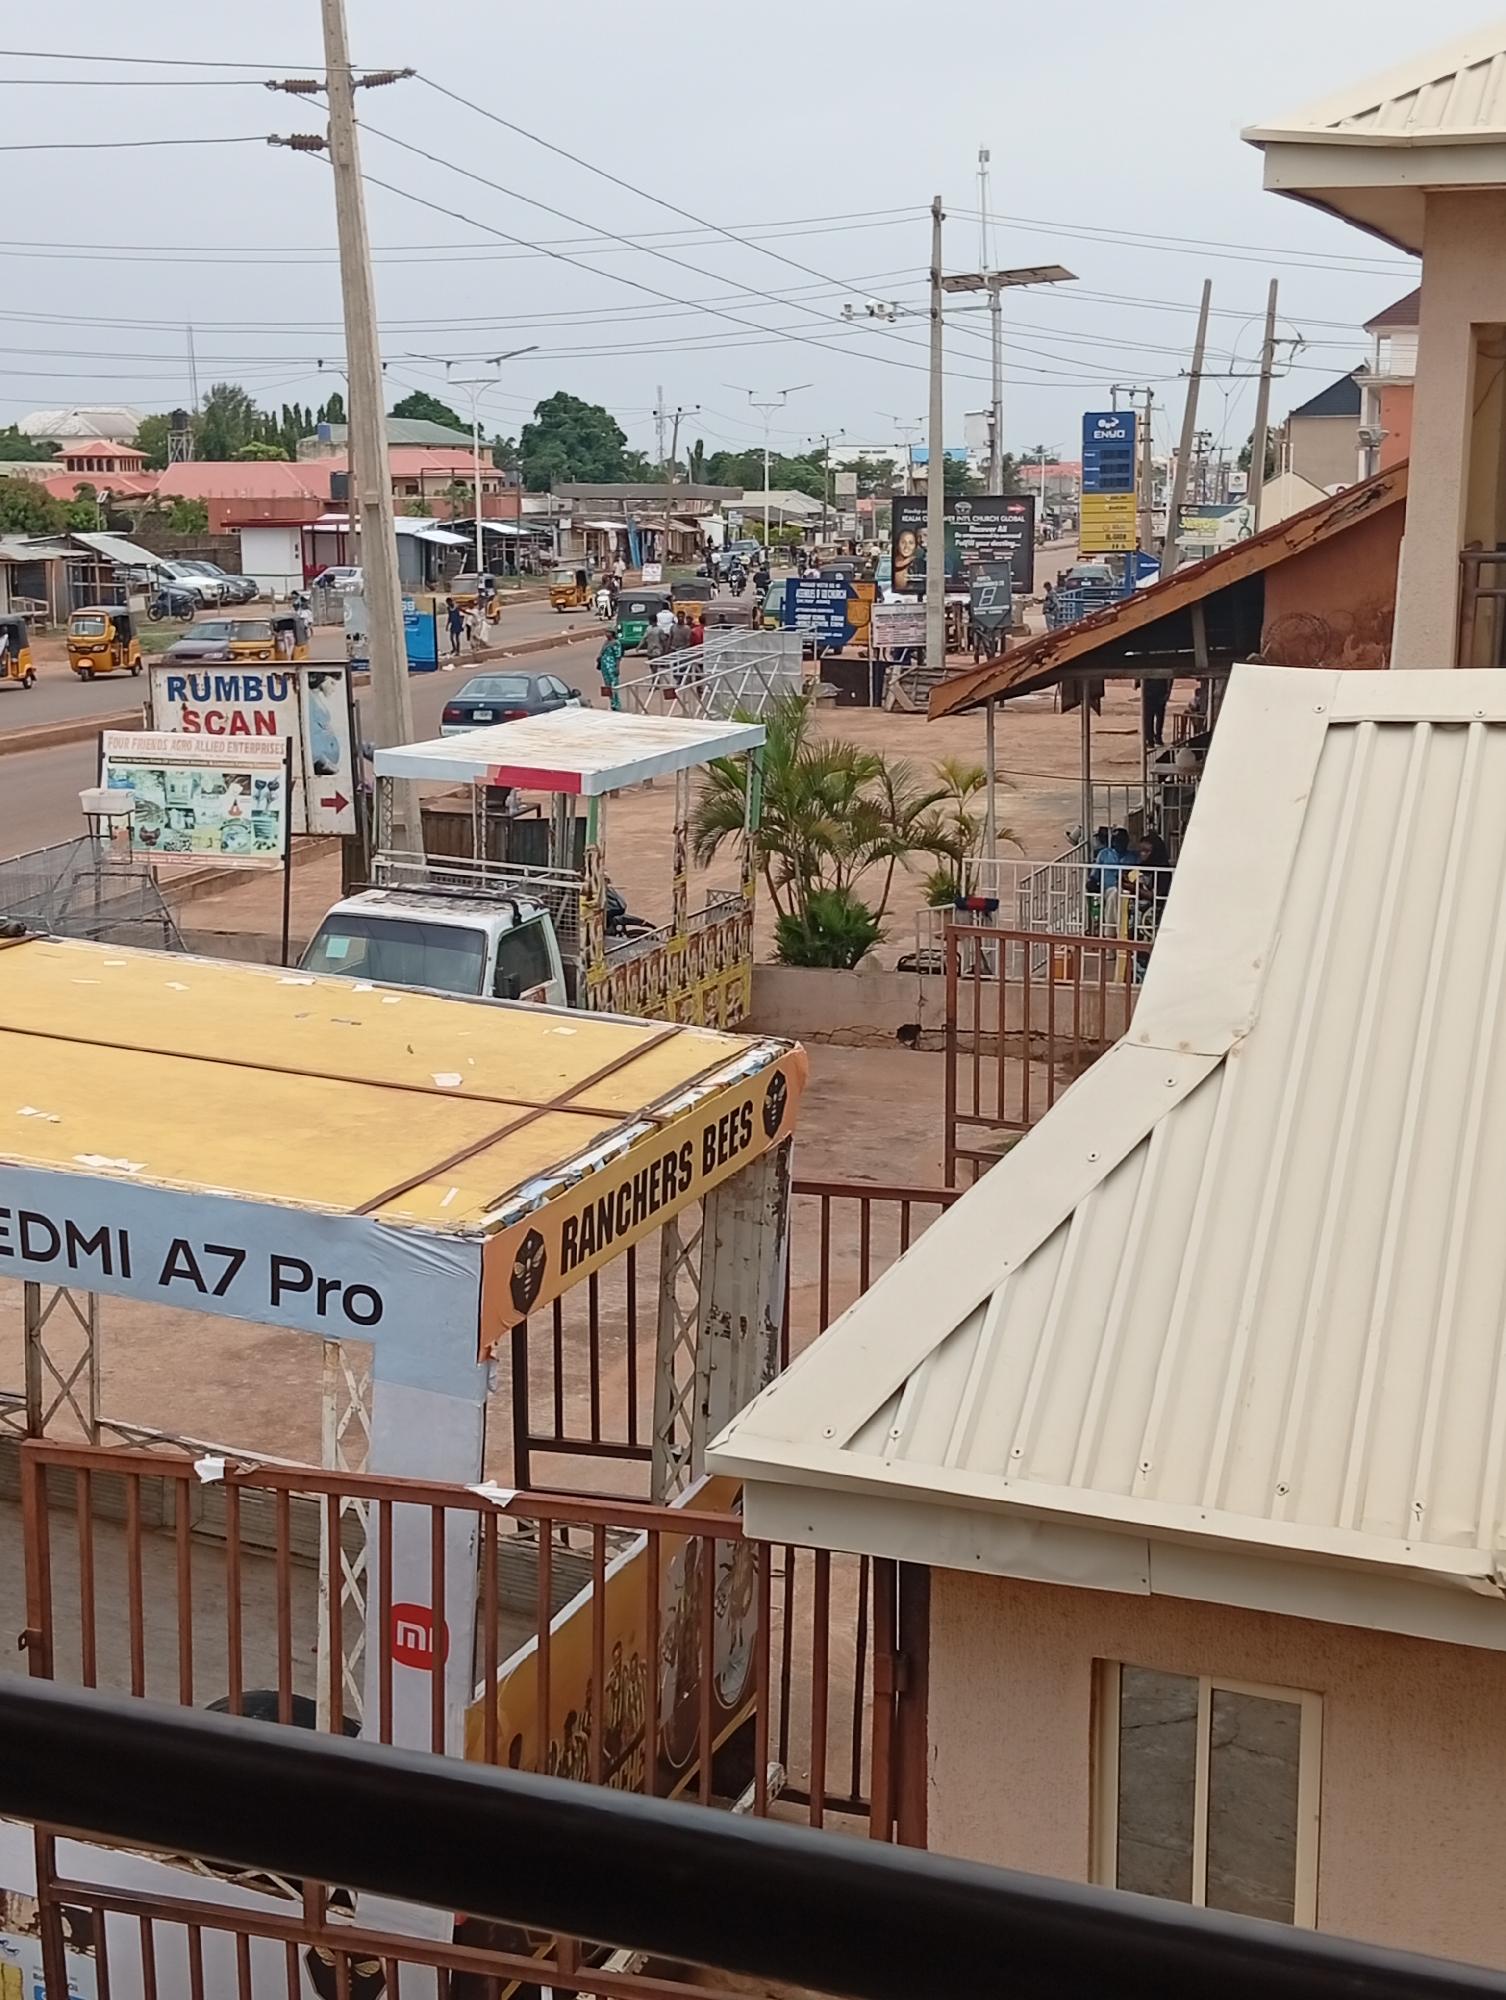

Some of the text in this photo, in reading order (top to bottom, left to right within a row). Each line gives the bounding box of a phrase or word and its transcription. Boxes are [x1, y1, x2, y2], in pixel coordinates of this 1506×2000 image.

[1093, 430, 1126, 439] ENYO
[167, 675, 288, 702] RUMBU
[182, 710, 277, 736] SCAN
[107, 737, 130, 750] FOUR
[131, 737, 168, 751] FRIENDS
[170, 740, 192, 752] AGRO
[195, 740, 225, 753] ALLIED
[227, 741, 285, 755] ENTERPRISES
[560, 1100, 753, 1276] RANCHERS BEES
[158, 1238, 246, 1297] A7
[270, 1253, 383, 1326] Pro
